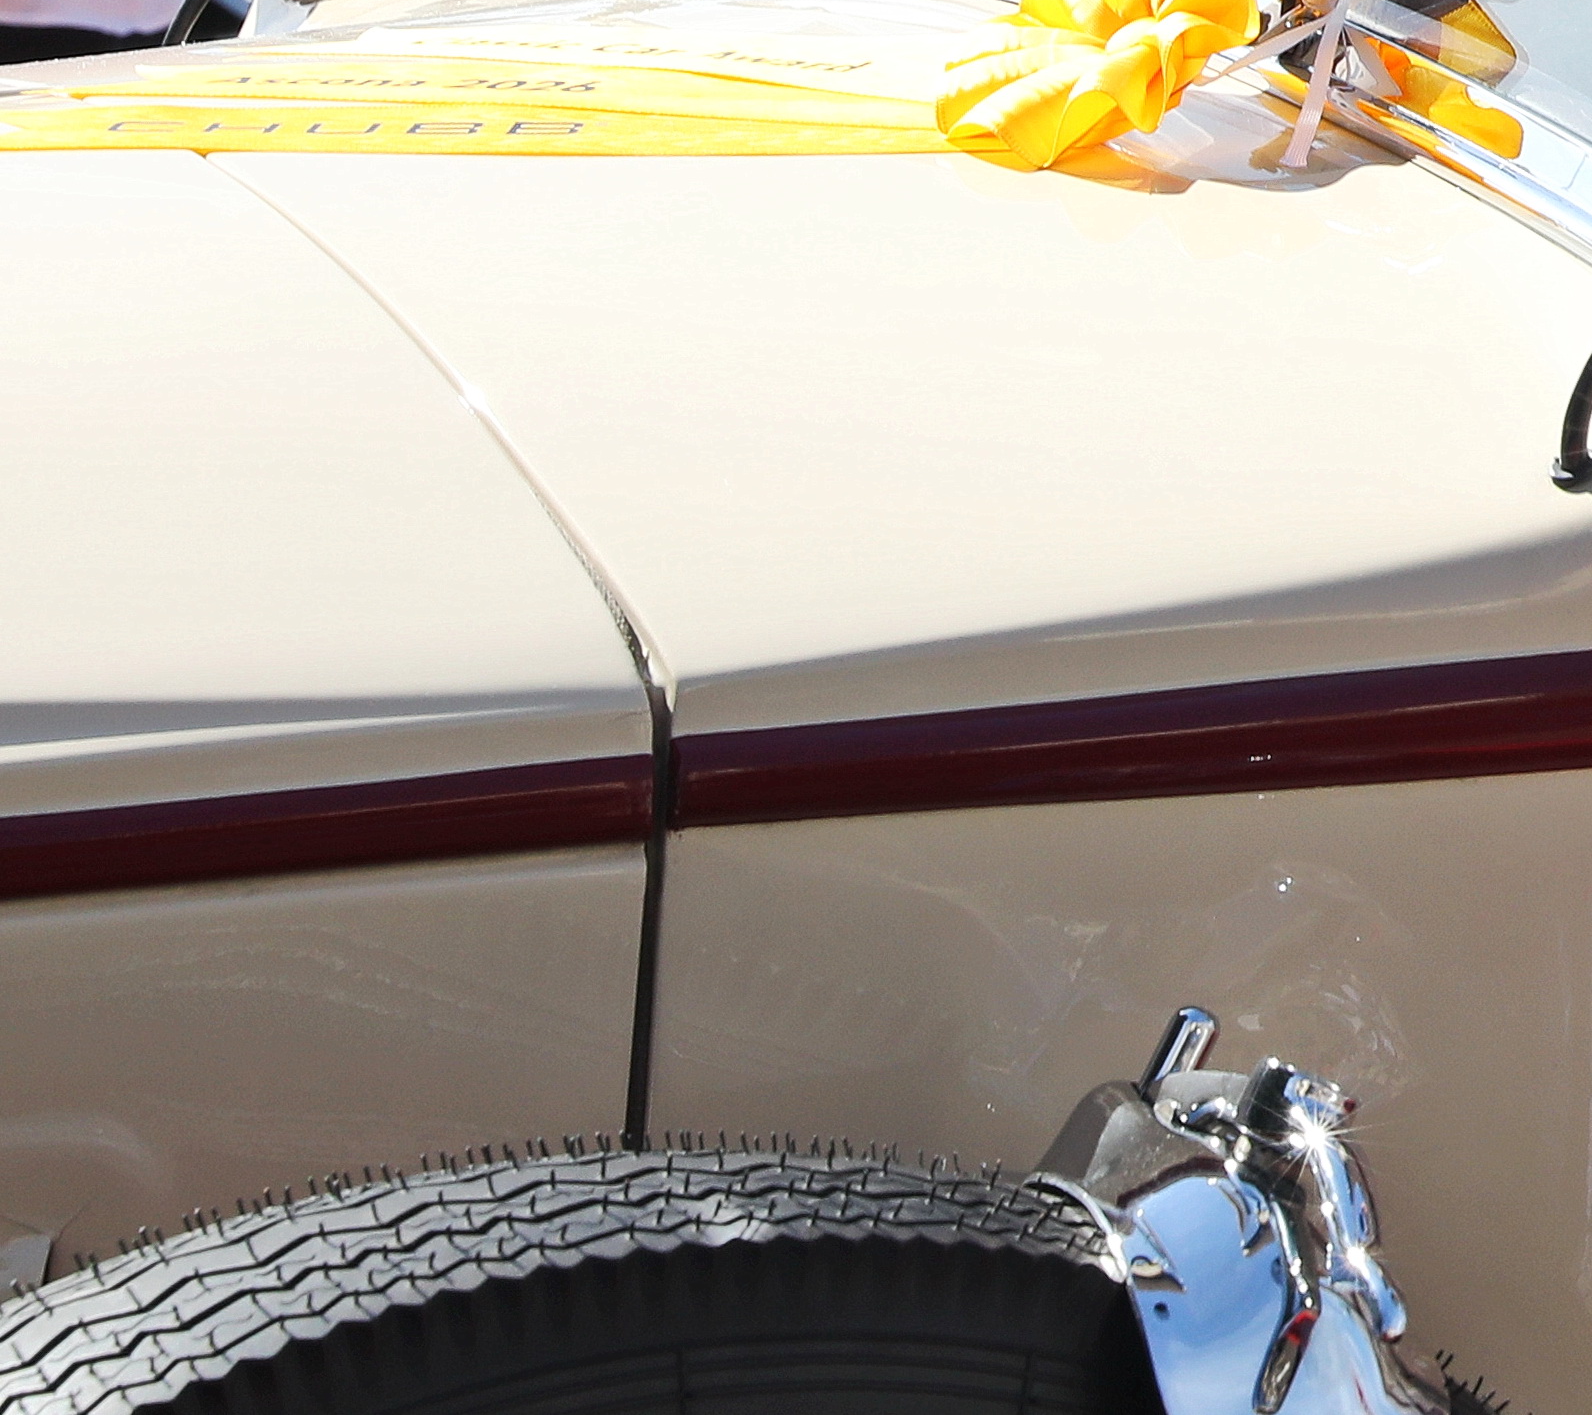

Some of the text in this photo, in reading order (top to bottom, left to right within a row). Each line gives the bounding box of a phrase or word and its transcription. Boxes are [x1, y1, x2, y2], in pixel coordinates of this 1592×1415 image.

[592, 43, 687, 57] Car
[703, 50, 872, 73] Award
[206, 76, 602, 93] Ascona 2026
[107, 120, 585, 135] CHUBB
